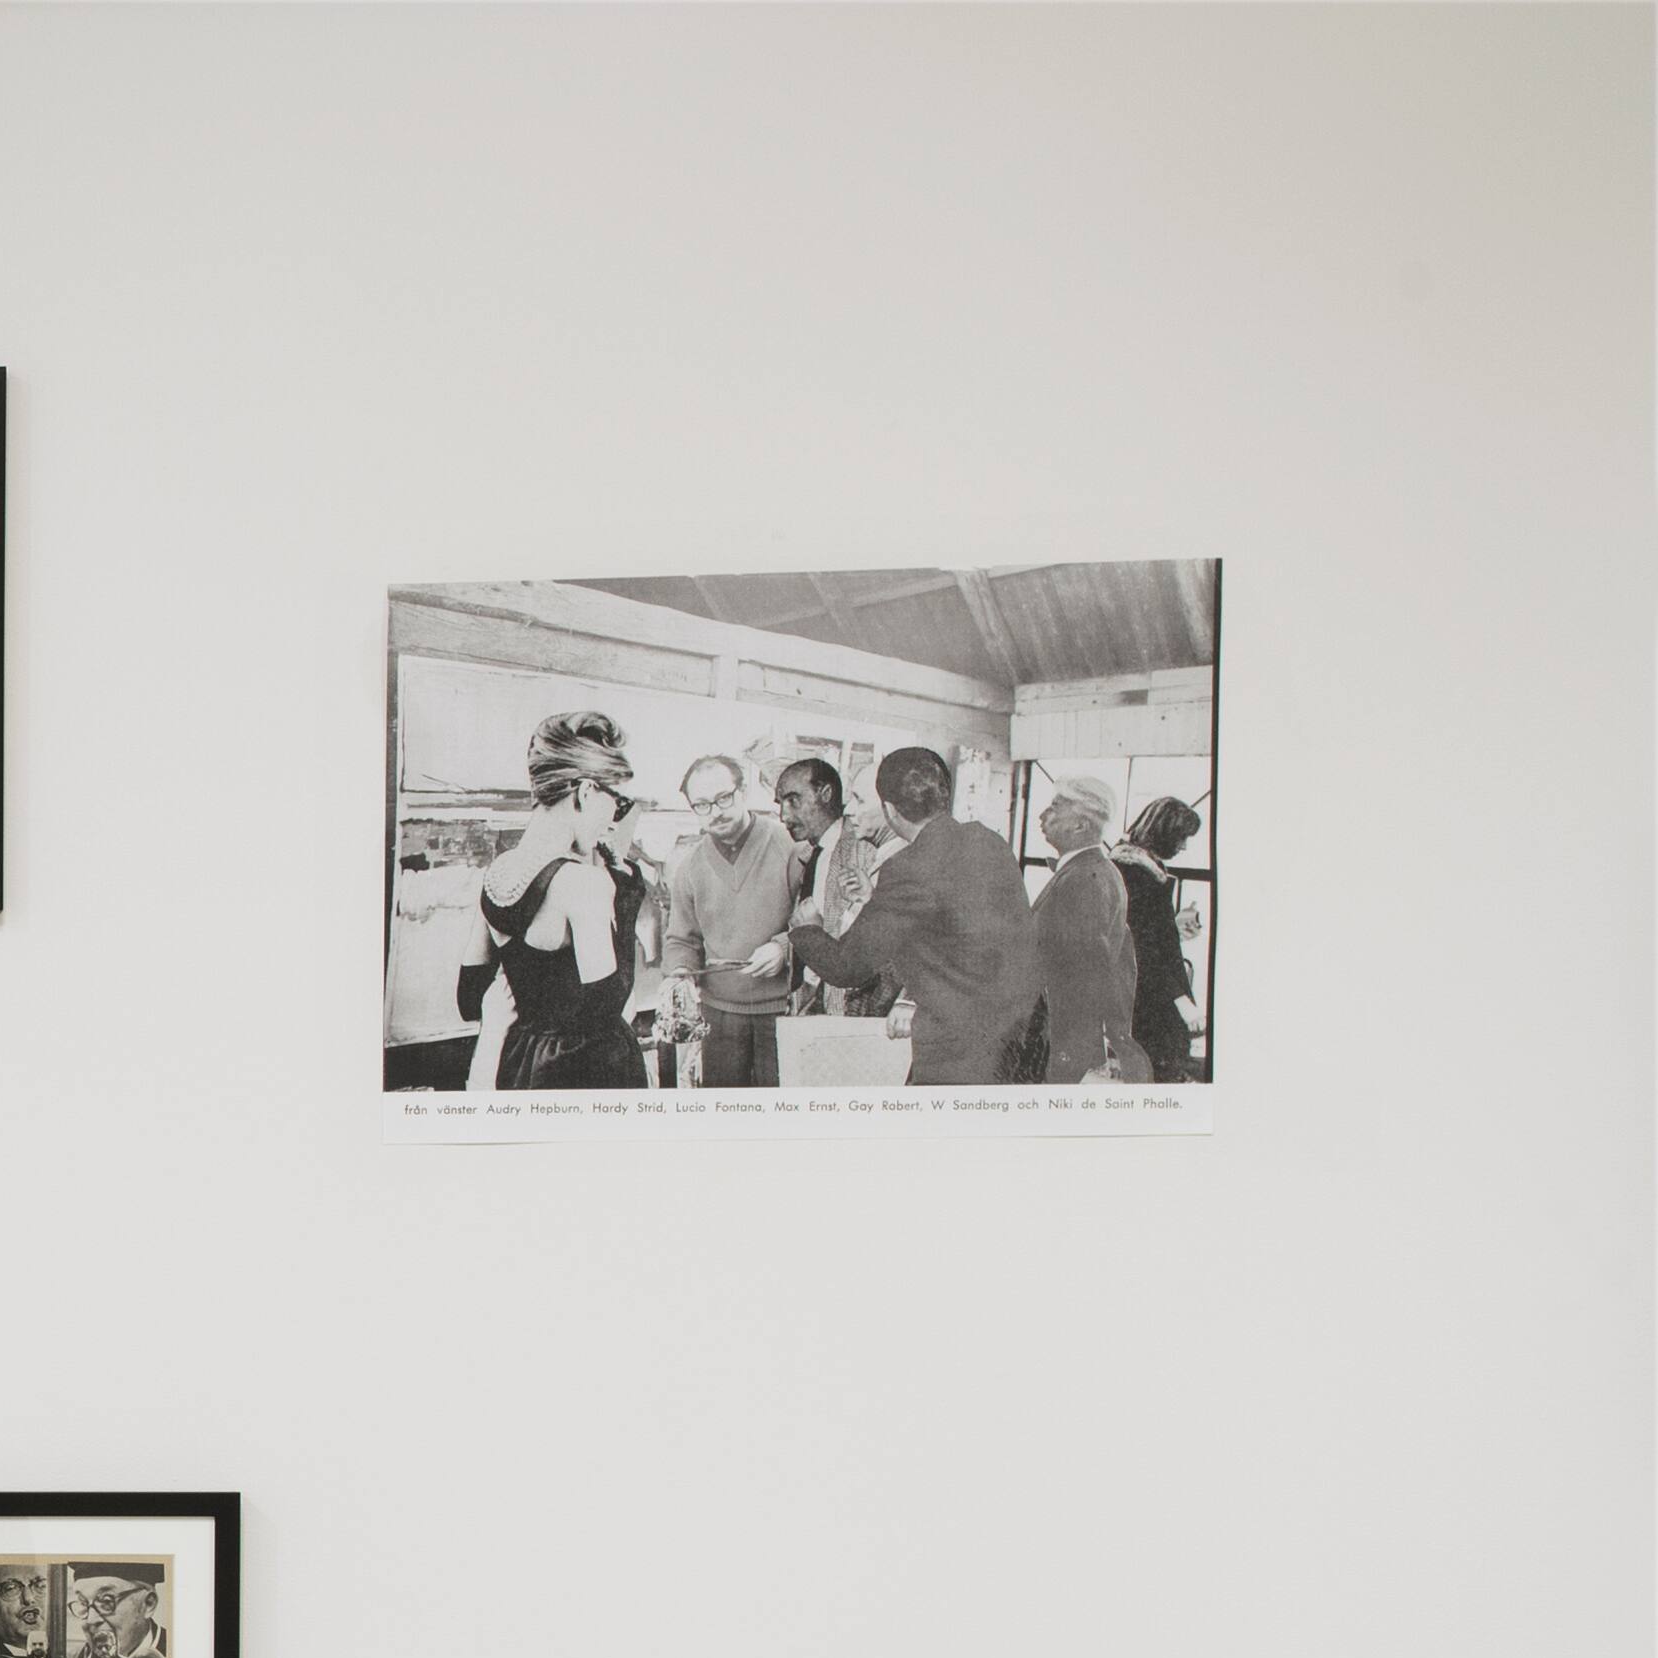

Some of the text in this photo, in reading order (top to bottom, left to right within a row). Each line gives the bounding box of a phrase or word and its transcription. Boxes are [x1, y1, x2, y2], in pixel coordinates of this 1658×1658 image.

[437, 1104, 478, 1115] vänster
[530, 1103, 584, 1116] Hepburn,
[592, 1102, 628, 1115] Hardy
[637, 1102, 667, 1114] Strid,
[675, 1102, 706, 1113] Lucio
[715, 1101, 766, 1114] Fontana,
[774, 1101, 800, 1112] Max
[809, 1101, 841, 1113] Ernst,
[931, 1099, 945, 1110] W
[953, 1099, 1009, 1113] Sandberg
[1017, 1098, 1039, 1110] och
[1049, 1098, 1073, 1110] Niki
[1081, 1098, 1096, 1110] de
[1105, 1098, 1134, 1110] Saint
